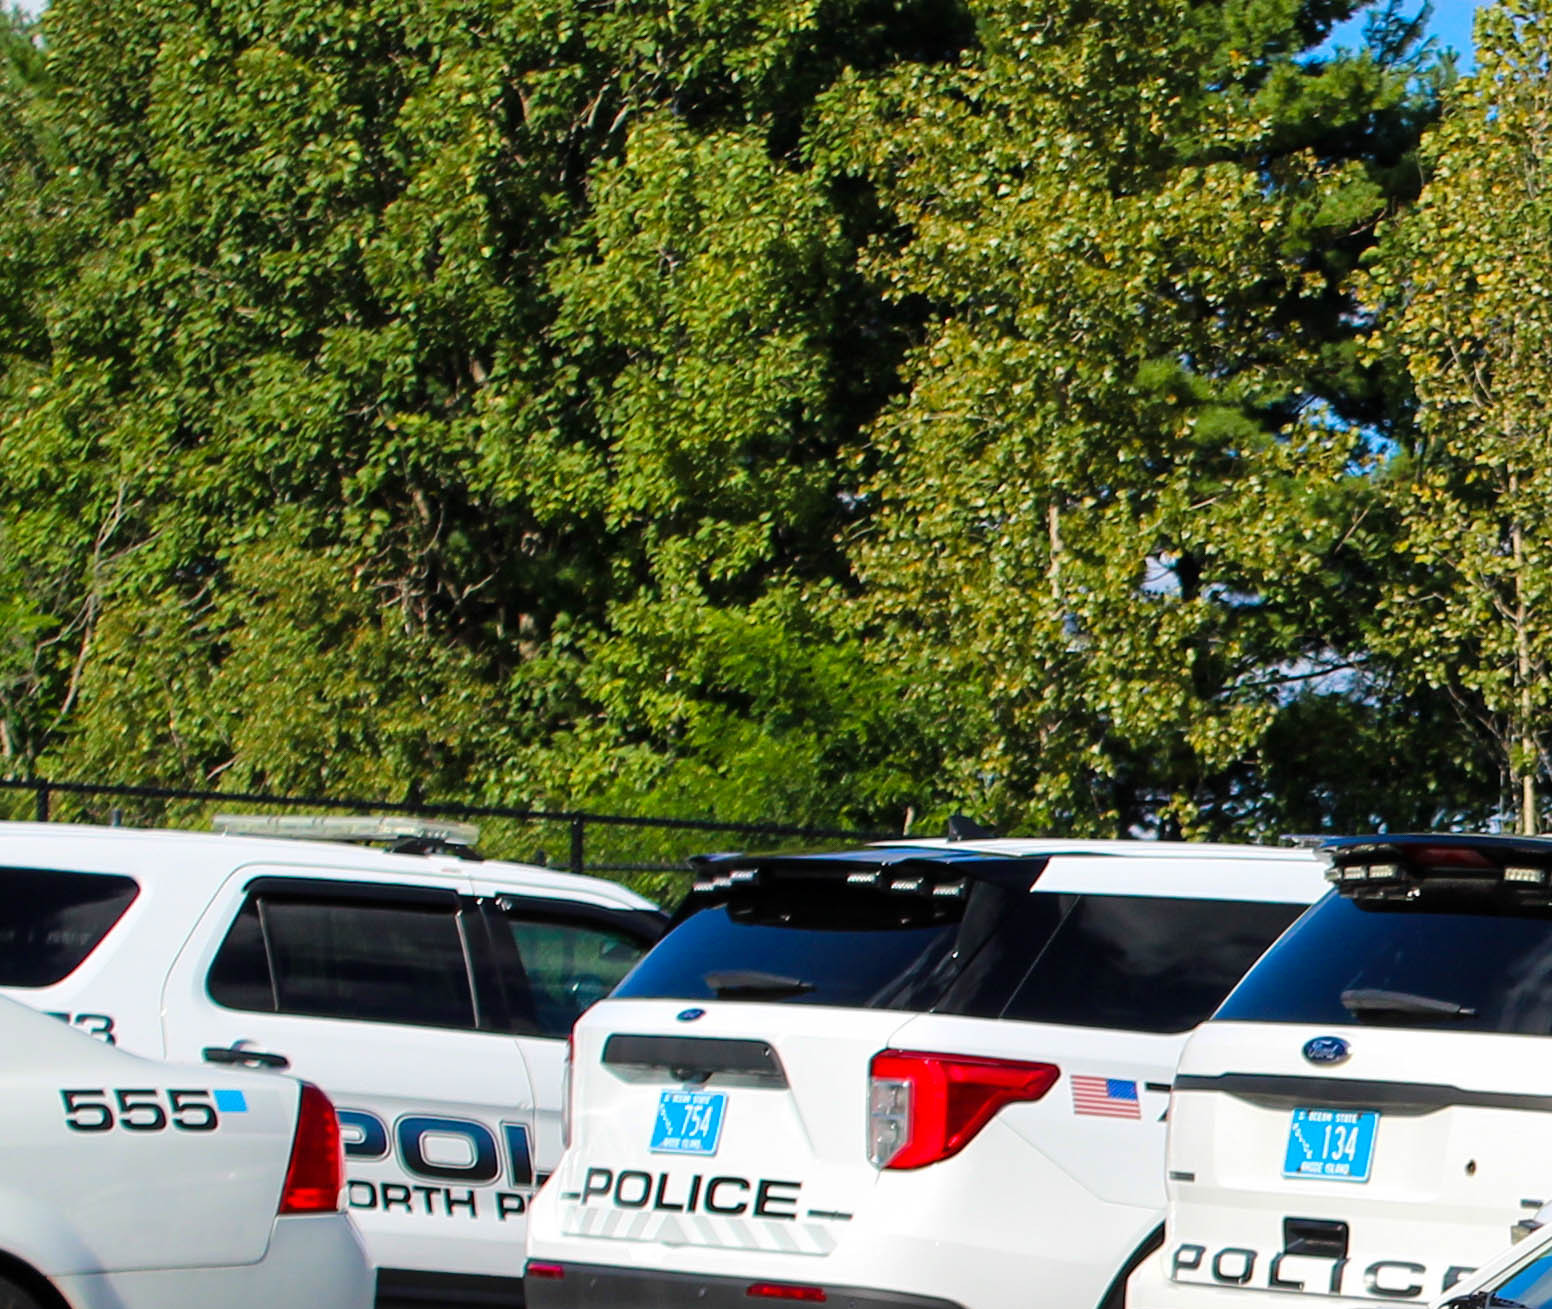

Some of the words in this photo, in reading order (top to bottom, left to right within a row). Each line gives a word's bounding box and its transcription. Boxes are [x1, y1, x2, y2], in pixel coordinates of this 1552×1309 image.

[60, 1089, 217, 1132] 555
[680, 1103, 713, 1138] 754
[1322, 1125, 1359, 1161] 134
[345, 1180, 477, 1219] ORTH
[581, 1167, 802, 1221] POLICE
